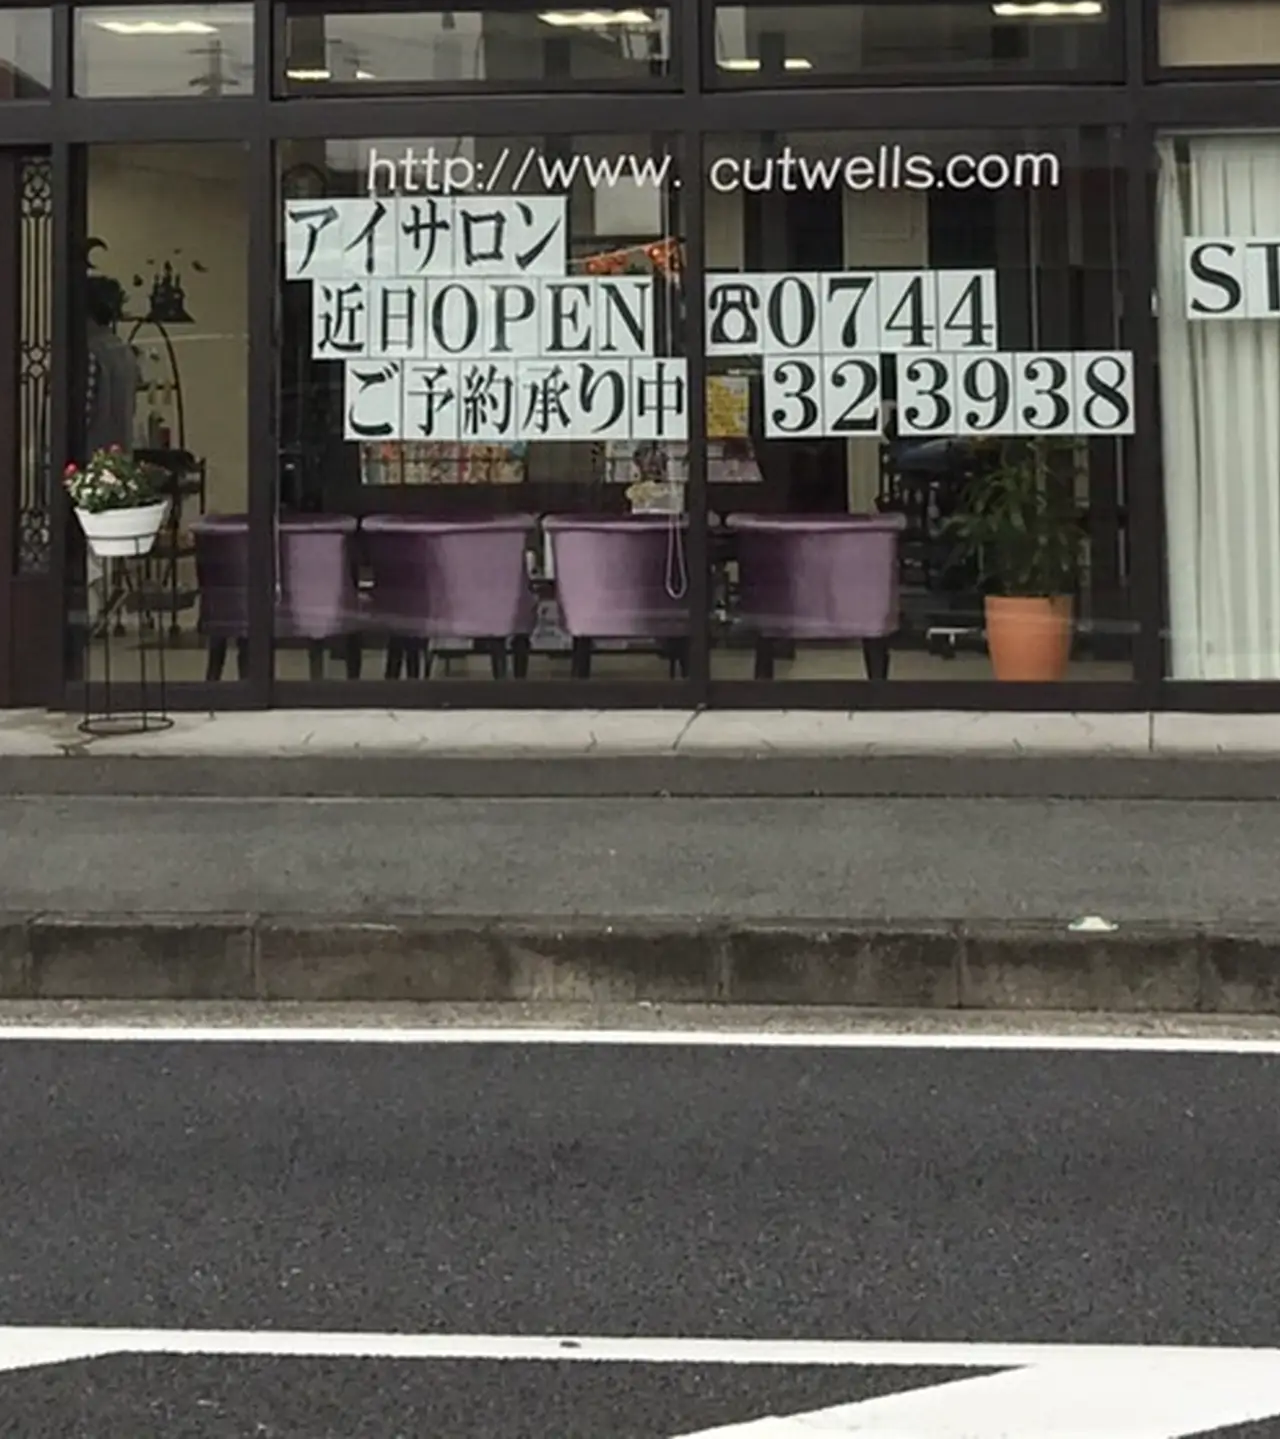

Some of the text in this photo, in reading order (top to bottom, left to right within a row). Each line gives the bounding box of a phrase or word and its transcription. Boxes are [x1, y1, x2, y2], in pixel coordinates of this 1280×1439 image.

[710, 144, 1061, 192] cutwells.com
[287, 200, 563, 274] アイサロン
[317, 280, 651, 353] 近日OPEN
[347, 361, 684, 437] ご予約承り中
